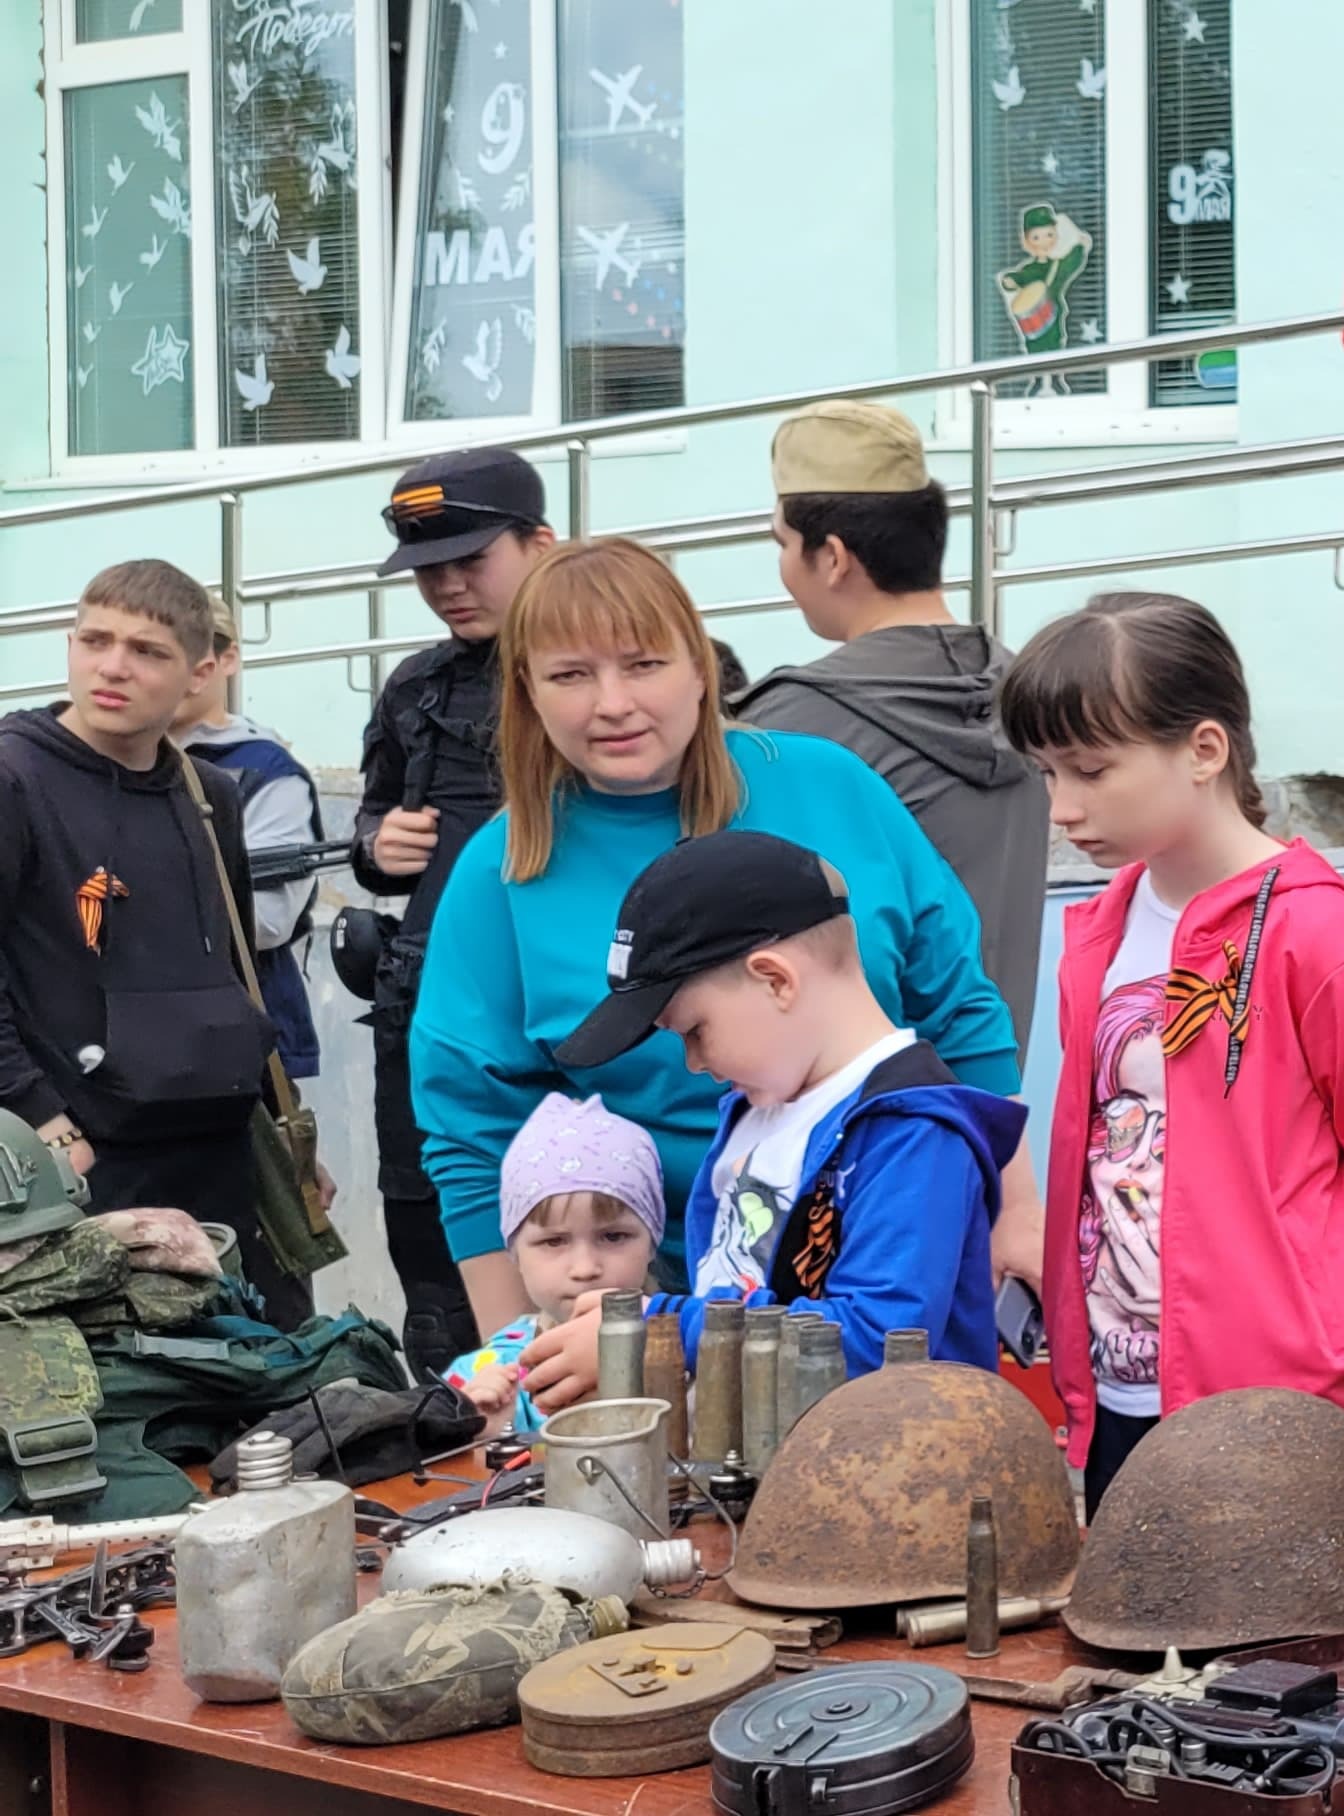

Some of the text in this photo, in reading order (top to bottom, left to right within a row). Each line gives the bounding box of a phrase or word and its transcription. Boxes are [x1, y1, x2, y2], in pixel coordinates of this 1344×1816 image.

[478, 82, 527, 176] 9
[1167, 164, 1197, 225] 9
[424, 225, 536, 286] МАЯ
